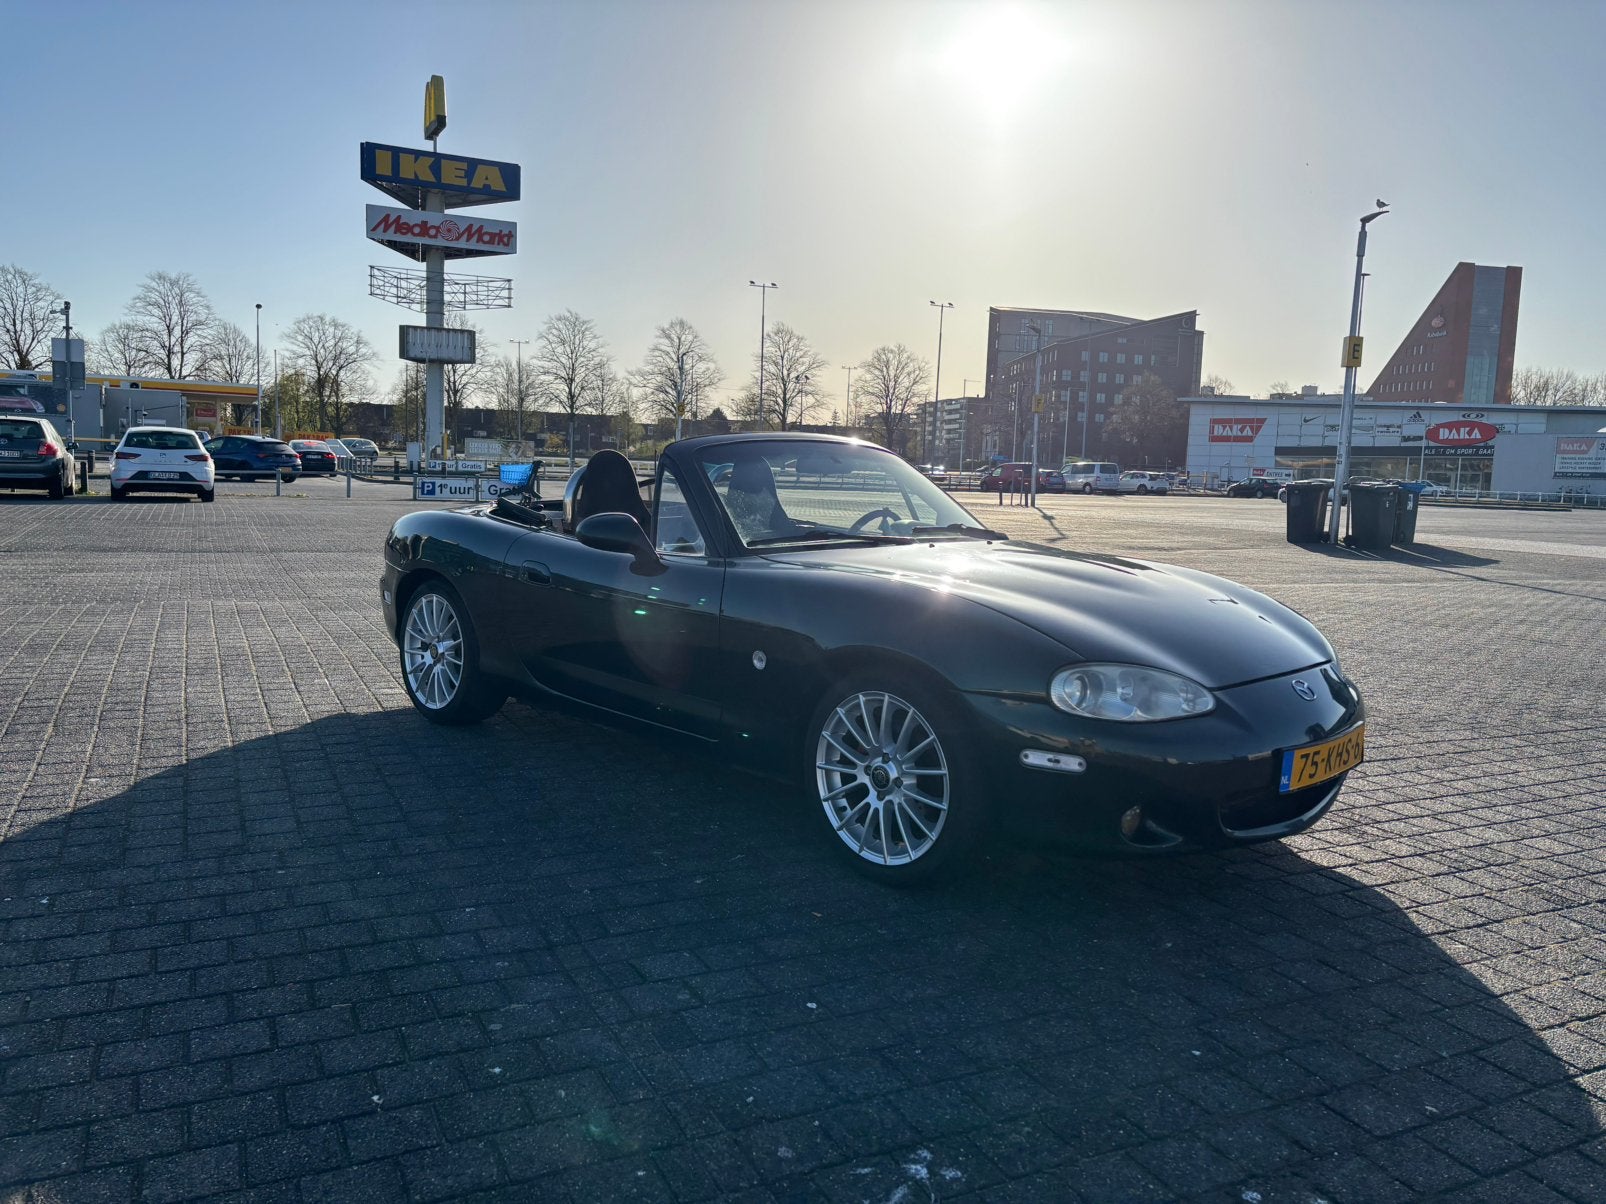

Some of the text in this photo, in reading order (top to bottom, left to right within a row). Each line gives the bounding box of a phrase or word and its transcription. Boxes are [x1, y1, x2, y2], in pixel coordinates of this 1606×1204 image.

[375, 149, 507, 192] IKEA
[1352, 343, 1361, 360] E
[1213, 424, 1253, 436] DAKA
[1439, 427, 1482, 440] DAKA
[1560, 442, 1588, 451] DAKA
[461, 462, 482, 470] Gratis
[450, 486, 473, 495] uur
[1297, 733, 1360, 783] 75-KHS-6
[1281, 775, 1289, 784] NL
